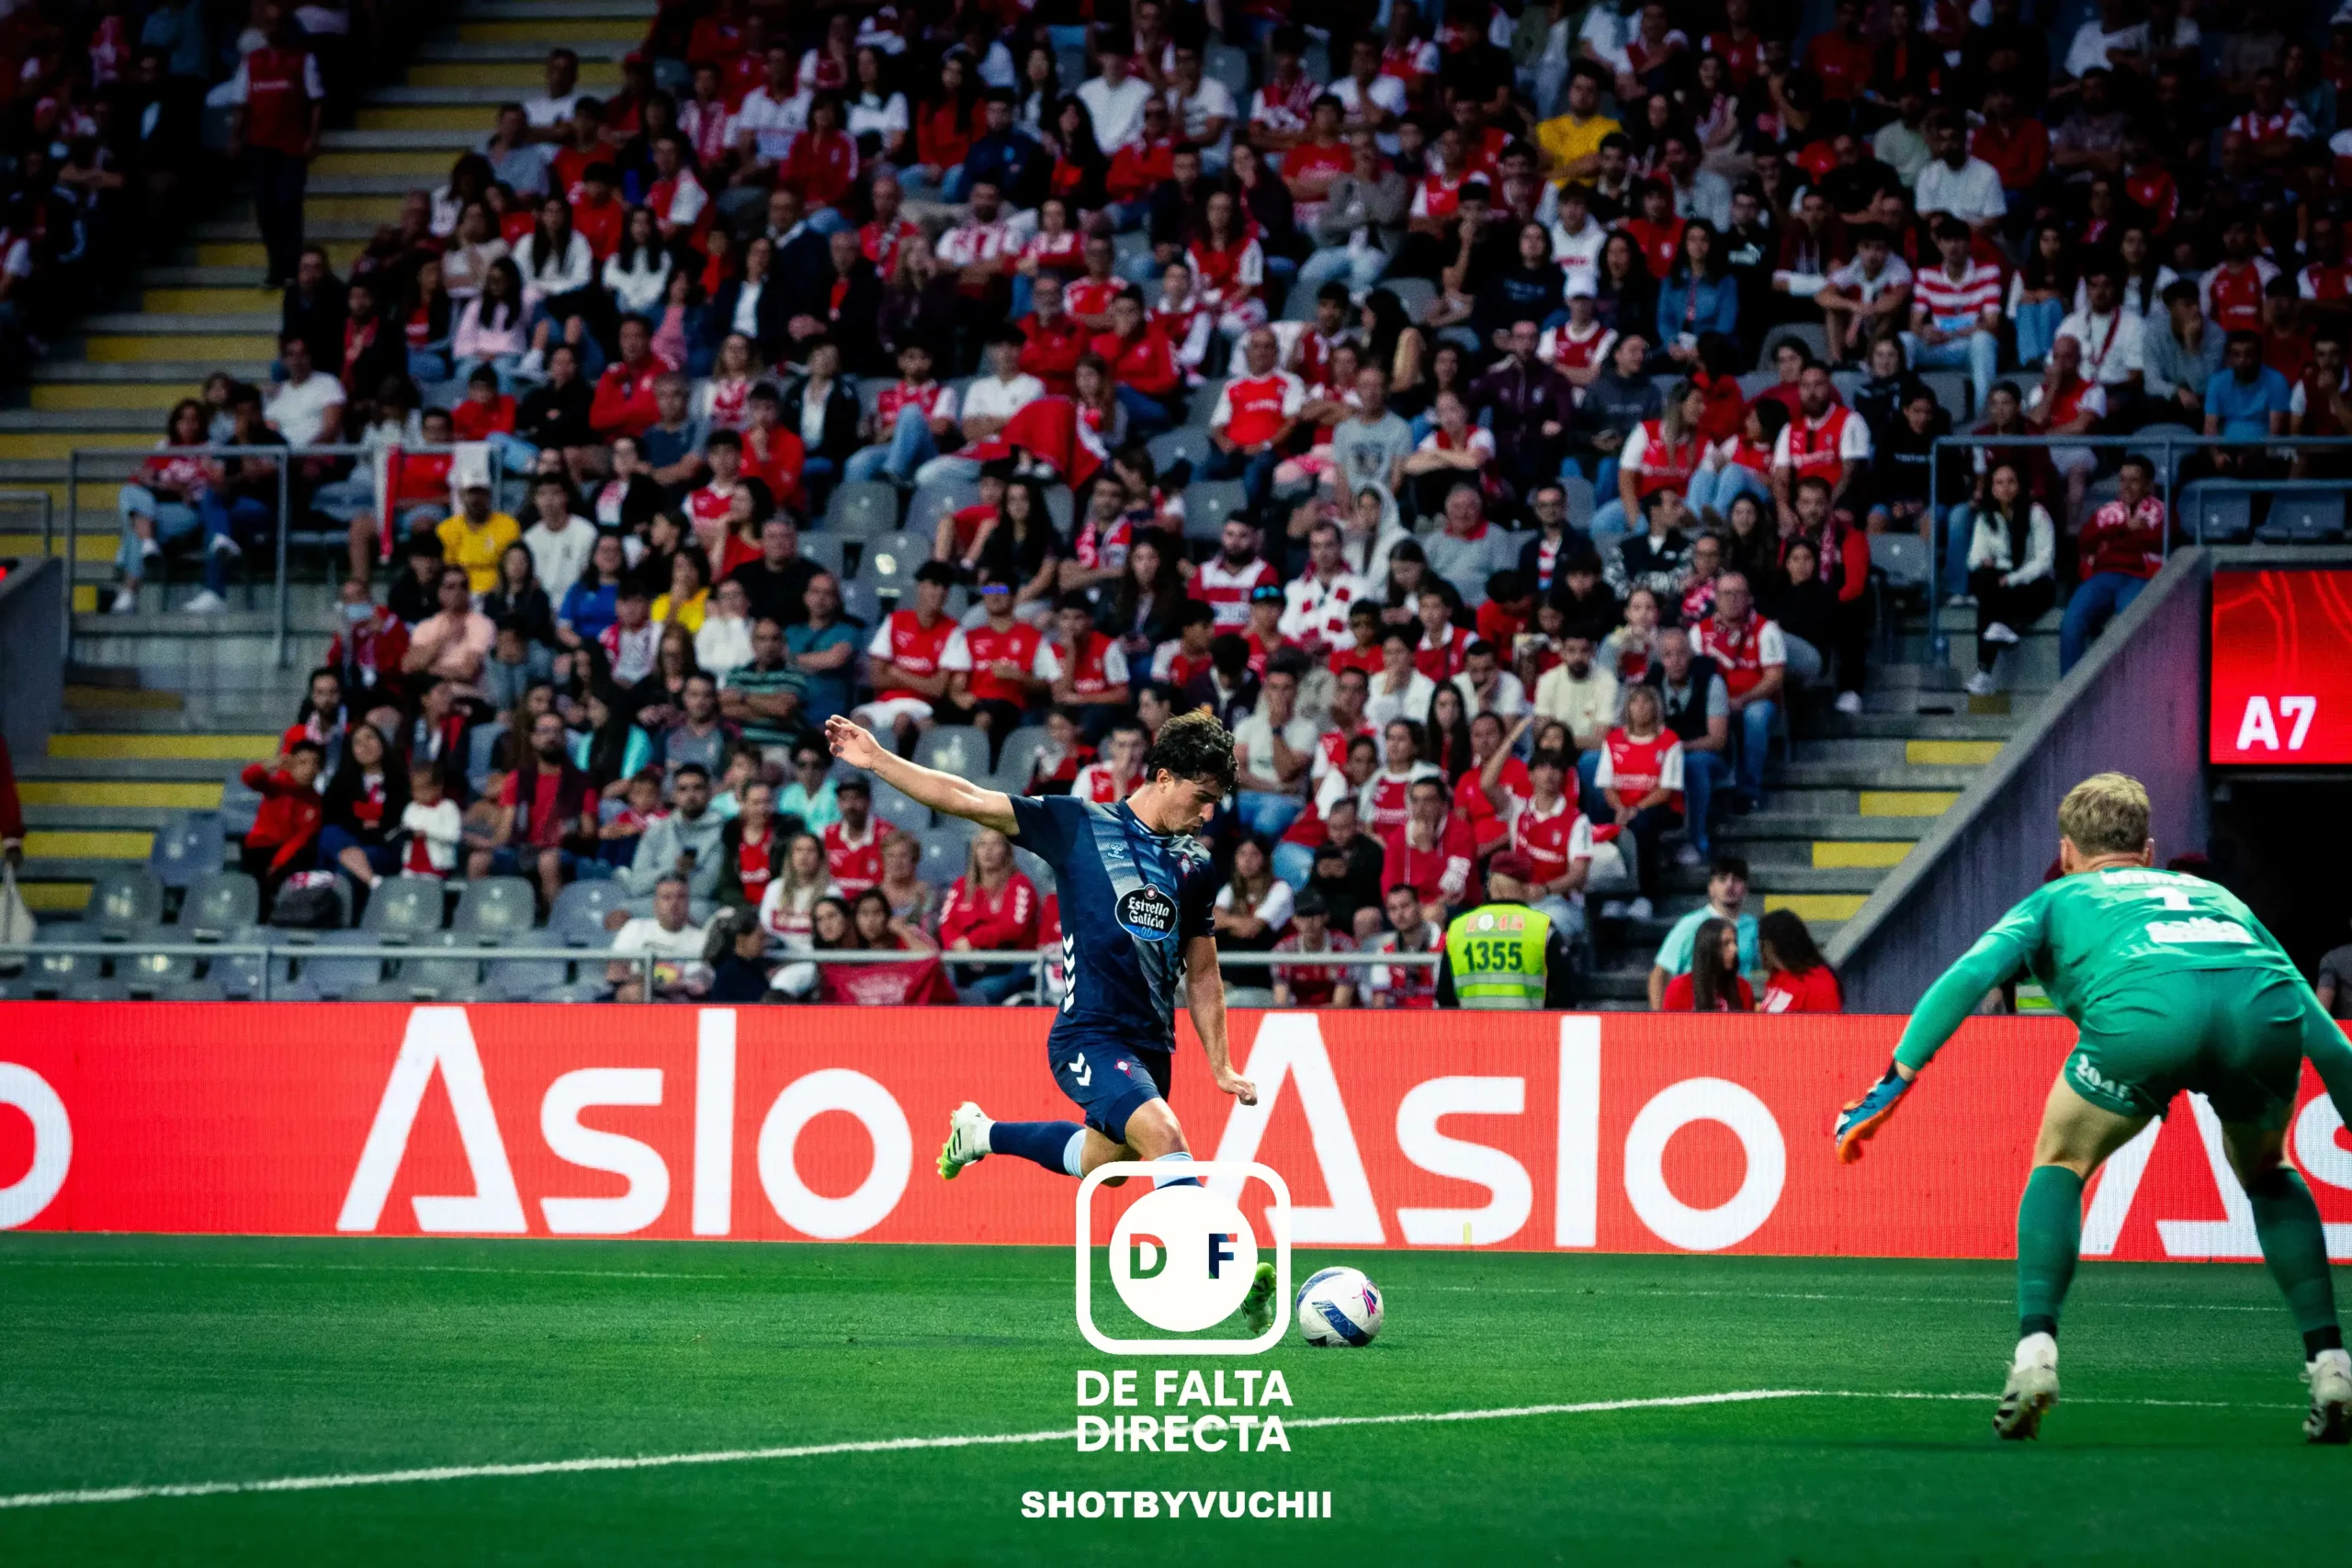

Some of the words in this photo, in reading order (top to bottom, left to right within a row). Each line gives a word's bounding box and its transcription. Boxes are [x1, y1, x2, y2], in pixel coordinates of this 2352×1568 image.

[2235, 695, 2317, 750] A7
[1127, 897, 1170, 917] Estrella
[1128, 909, 1165, 930] Galicia
[1464, 941, 1523, 971] 1355
[336, 1007, 912, 1239] Aslo
[1198, 1012, 1786, 1250] Aslo
